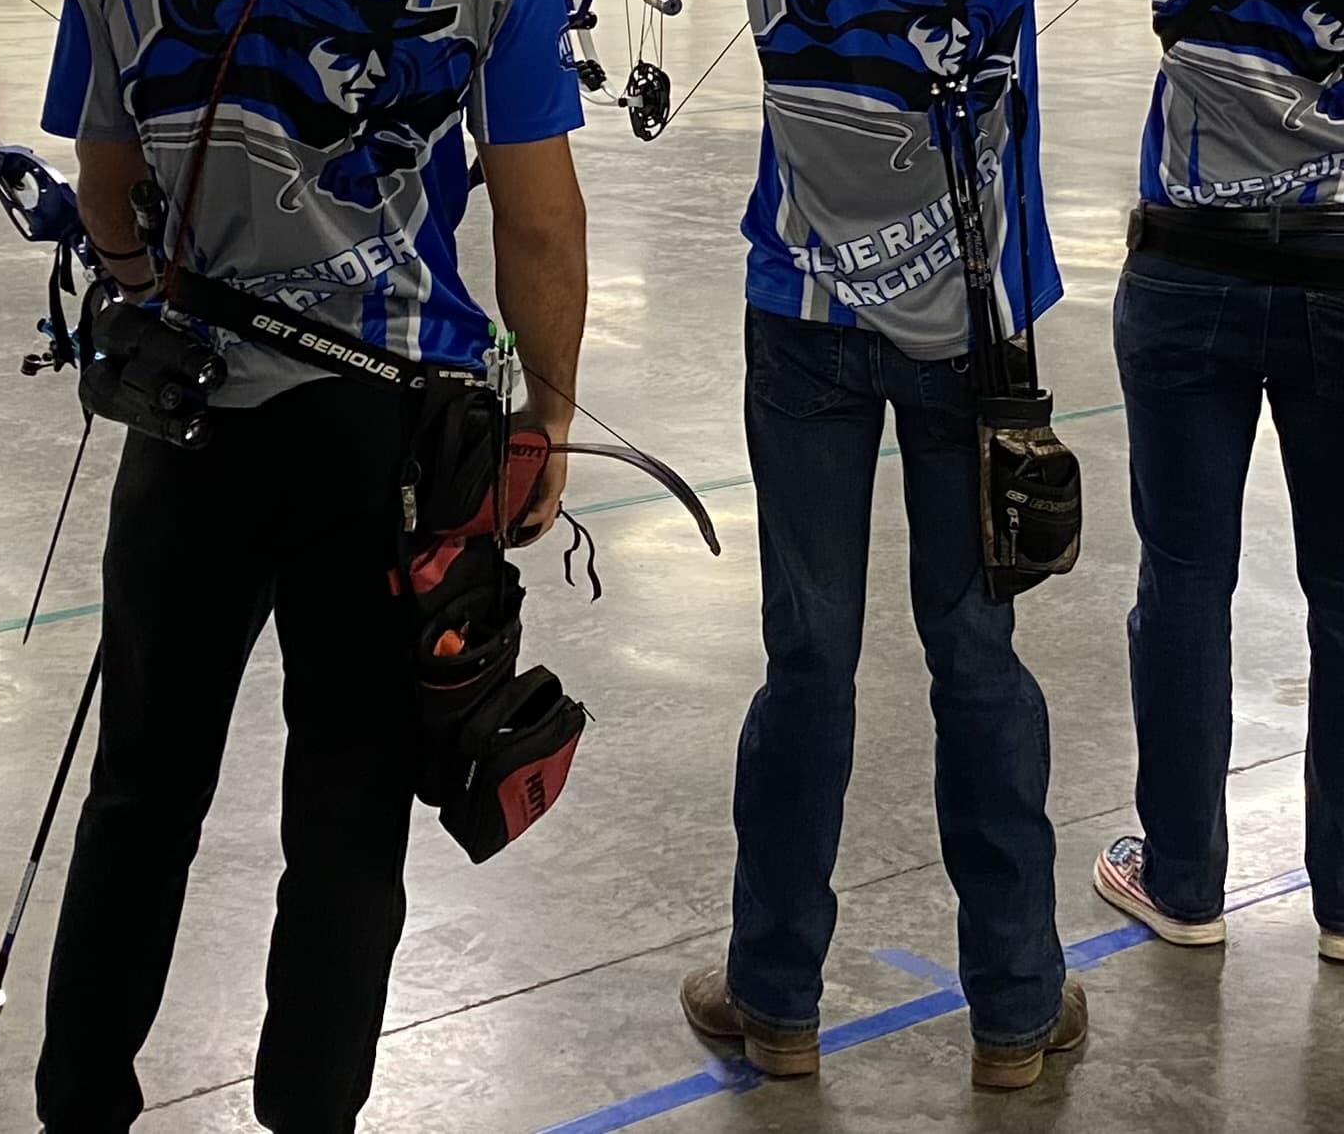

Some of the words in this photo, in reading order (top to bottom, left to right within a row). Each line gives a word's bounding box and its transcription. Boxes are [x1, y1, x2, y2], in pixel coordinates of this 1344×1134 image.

[787, 234, 882, 276] BLUE
[251, 314, 298, 339] GET
[298, 332, 402, 384] SERIOUS.
